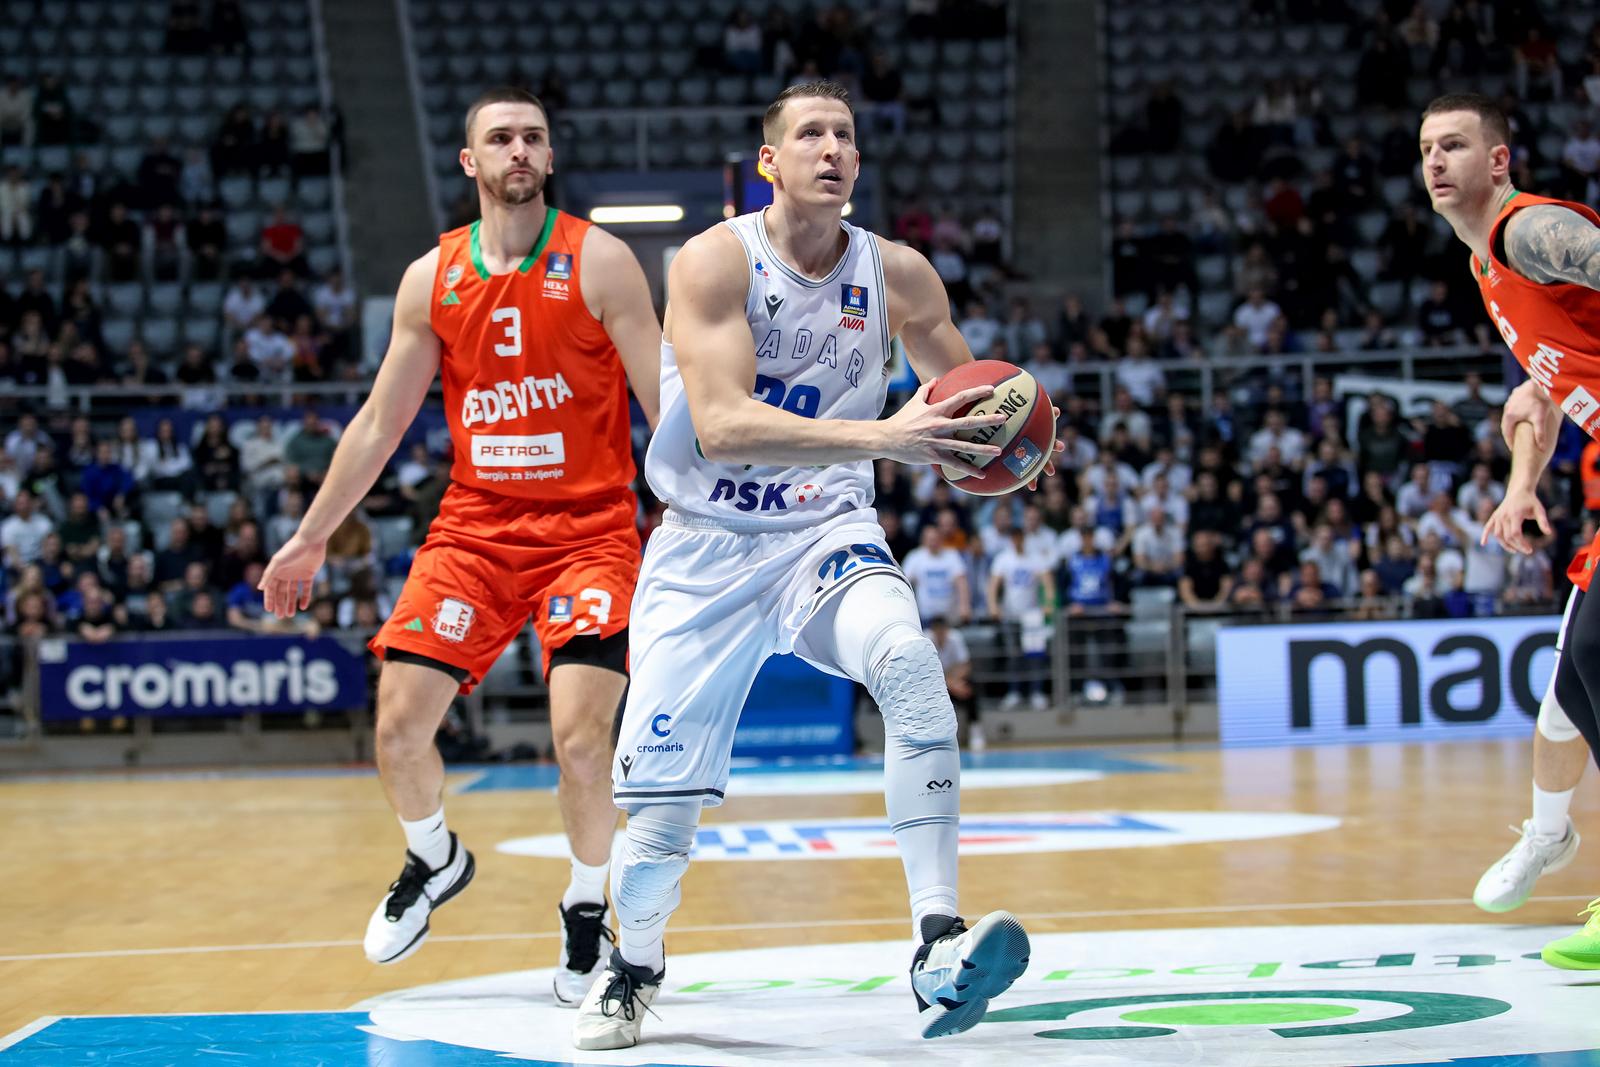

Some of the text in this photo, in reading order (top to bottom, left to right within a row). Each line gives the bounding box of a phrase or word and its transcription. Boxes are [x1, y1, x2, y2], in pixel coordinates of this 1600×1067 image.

[491, 306, 522, 357] 3
[837, 315, 865, 332] AVIA
[756, 328, 865, 389] ADAR
[461, 372, 574, 429] CEDEVITA
[480, 444, 555, 457] PETROL
[511, 472, 522, 480] za
[708, 478, 792, 512] PSK
[817, 543, 896, 581] 29
[575, 587, 612, 635] 3
[66, 646, 339, 711] cromaris
[636, 741, 684, 753] cromaris
[1300, 951, 1543, 970] tp
